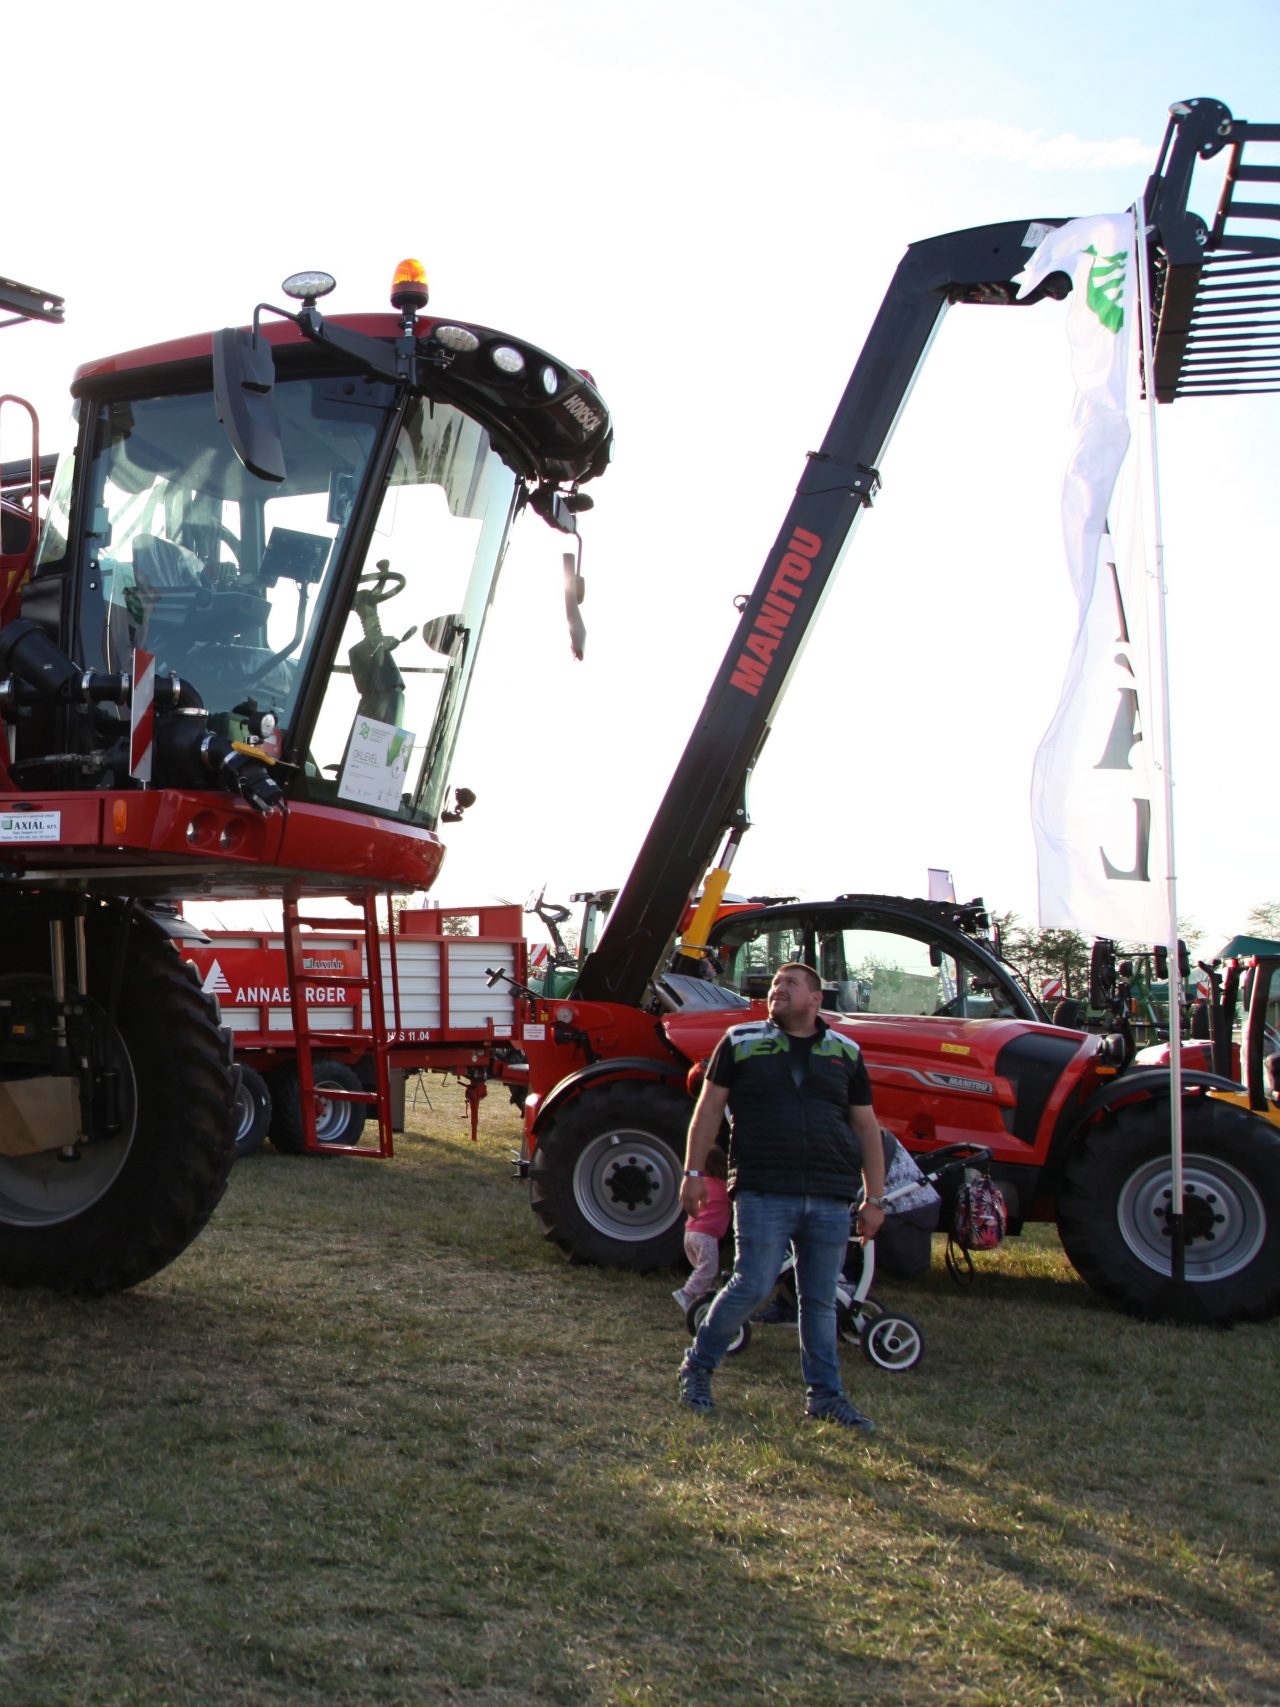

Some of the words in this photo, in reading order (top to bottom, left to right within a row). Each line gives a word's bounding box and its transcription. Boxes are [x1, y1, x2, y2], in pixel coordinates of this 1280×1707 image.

[563, 394, 601, 432] HORSCH
[729, 526, 822, 697] MANITOU
[313, 957, 344, 970] AXIÁL
[235, 986, 346, 1003] ANNABRGER
[948, 1077, 988, 1091] MANITOU
